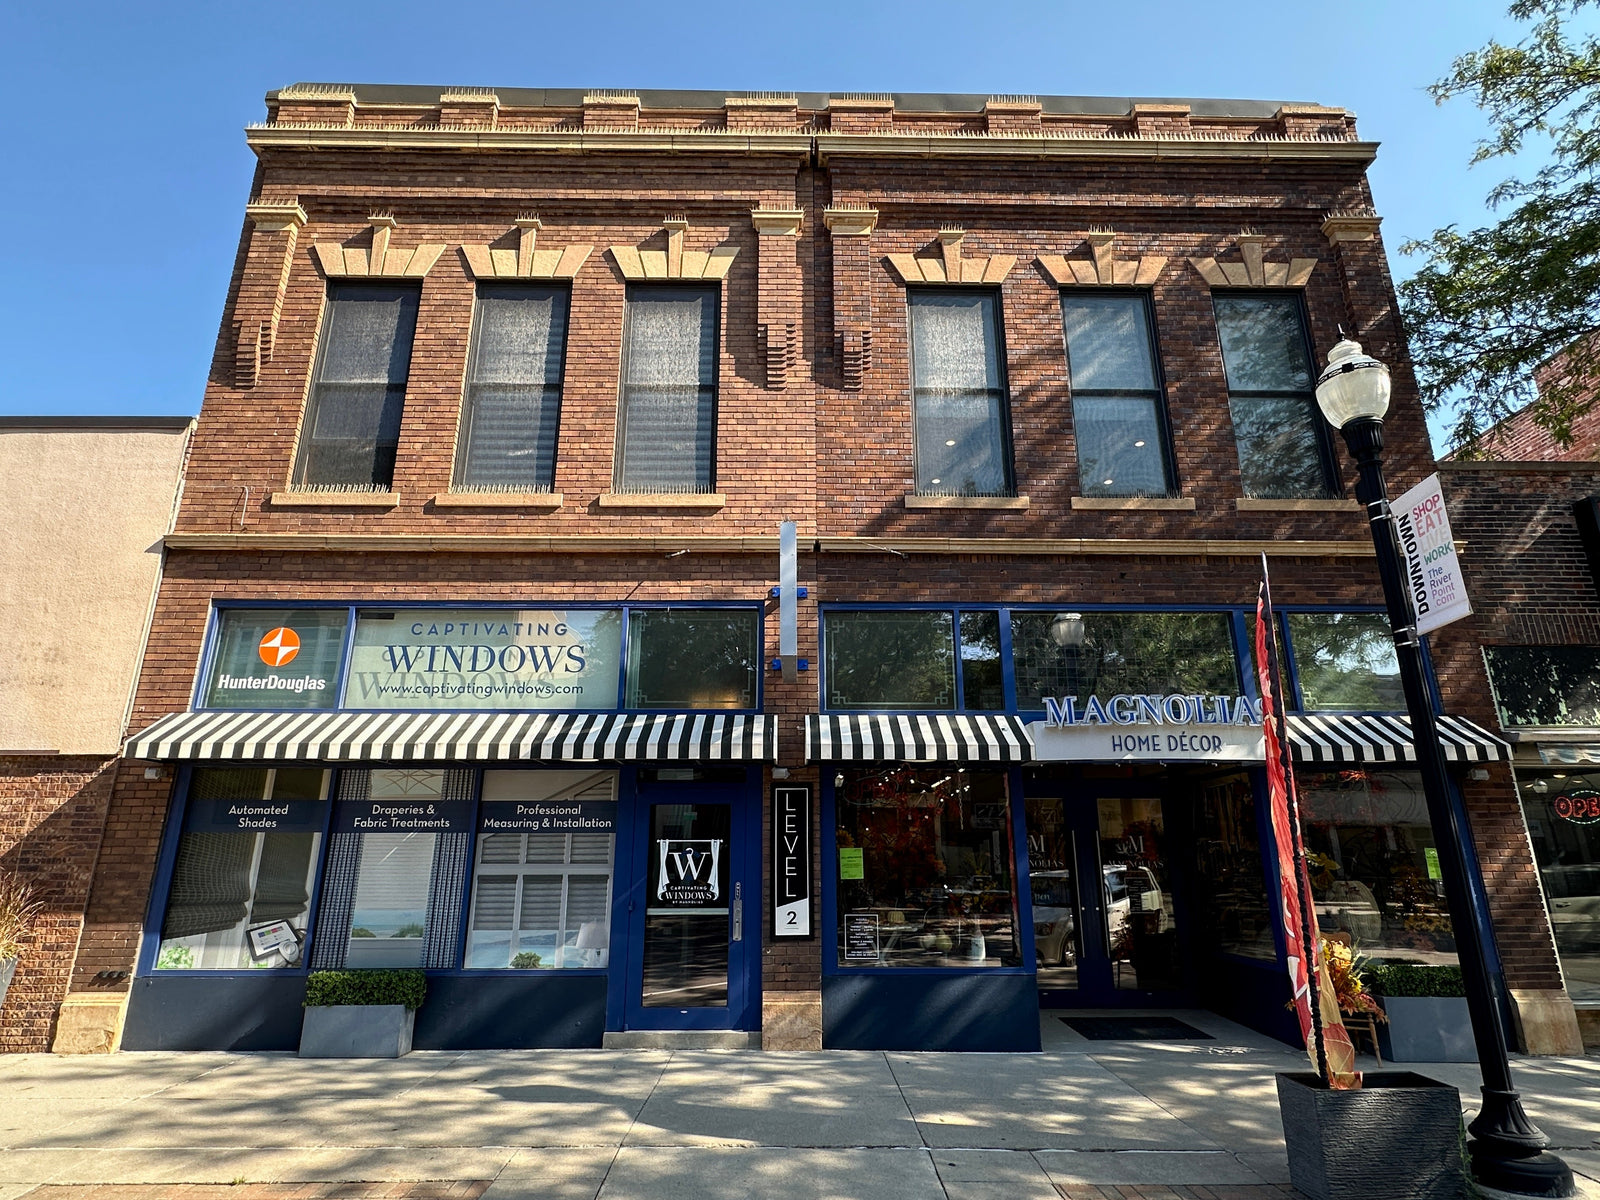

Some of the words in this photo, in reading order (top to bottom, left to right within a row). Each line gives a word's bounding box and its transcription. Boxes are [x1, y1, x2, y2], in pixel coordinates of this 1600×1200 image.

[1413, 494, 1440, 521] SHOP
[1416, 507, 1443, 538] EAT
[1420, 528, 1449, 554] LIVE
[1424, 541, 1453, 566] WORK
[1398, 512, 1430, 616] DOWNTOWN
[1428, 565, 1444, 580] The
[1429, 572, 1452, 590] River
[1432, 584, 1455, 602] Point
[1434, 592, 1455, 609] .com
[410, 622, 569, 637] CAPTIVATING
[385, 643, 586, 674] WINDOWS
[217, 674, 326, 694] HunterDouglas
[379, 681, 584, 698] www.captivatingwindows.com
[1112, 734, 1161, 752] HOME
[1167, 730, 1223, 753] DÉCOR
[228, 804, 289, 816] Automated
[371, 804, 423, 818] Draperies
[426, 804, 435, 816] &
[516, 804, 582, 816] Professional
[1553, 795, 1600, 818] OPE
[237, 817, 277, 829] Shades
[353, 817, 388, 829] Fabric
[390, 817, 450, 829] Treatments
[483, 817, 539, 831] Measuring
[541, 817, 551, 829] &
[553, 817, 612, 829] Installation
[784, 792, 799, 898] LEVEL
[668, 848, 711, 881] W
[665, 891, 712, 900] WINDOWS
[786, 911, 797, 925] 2
